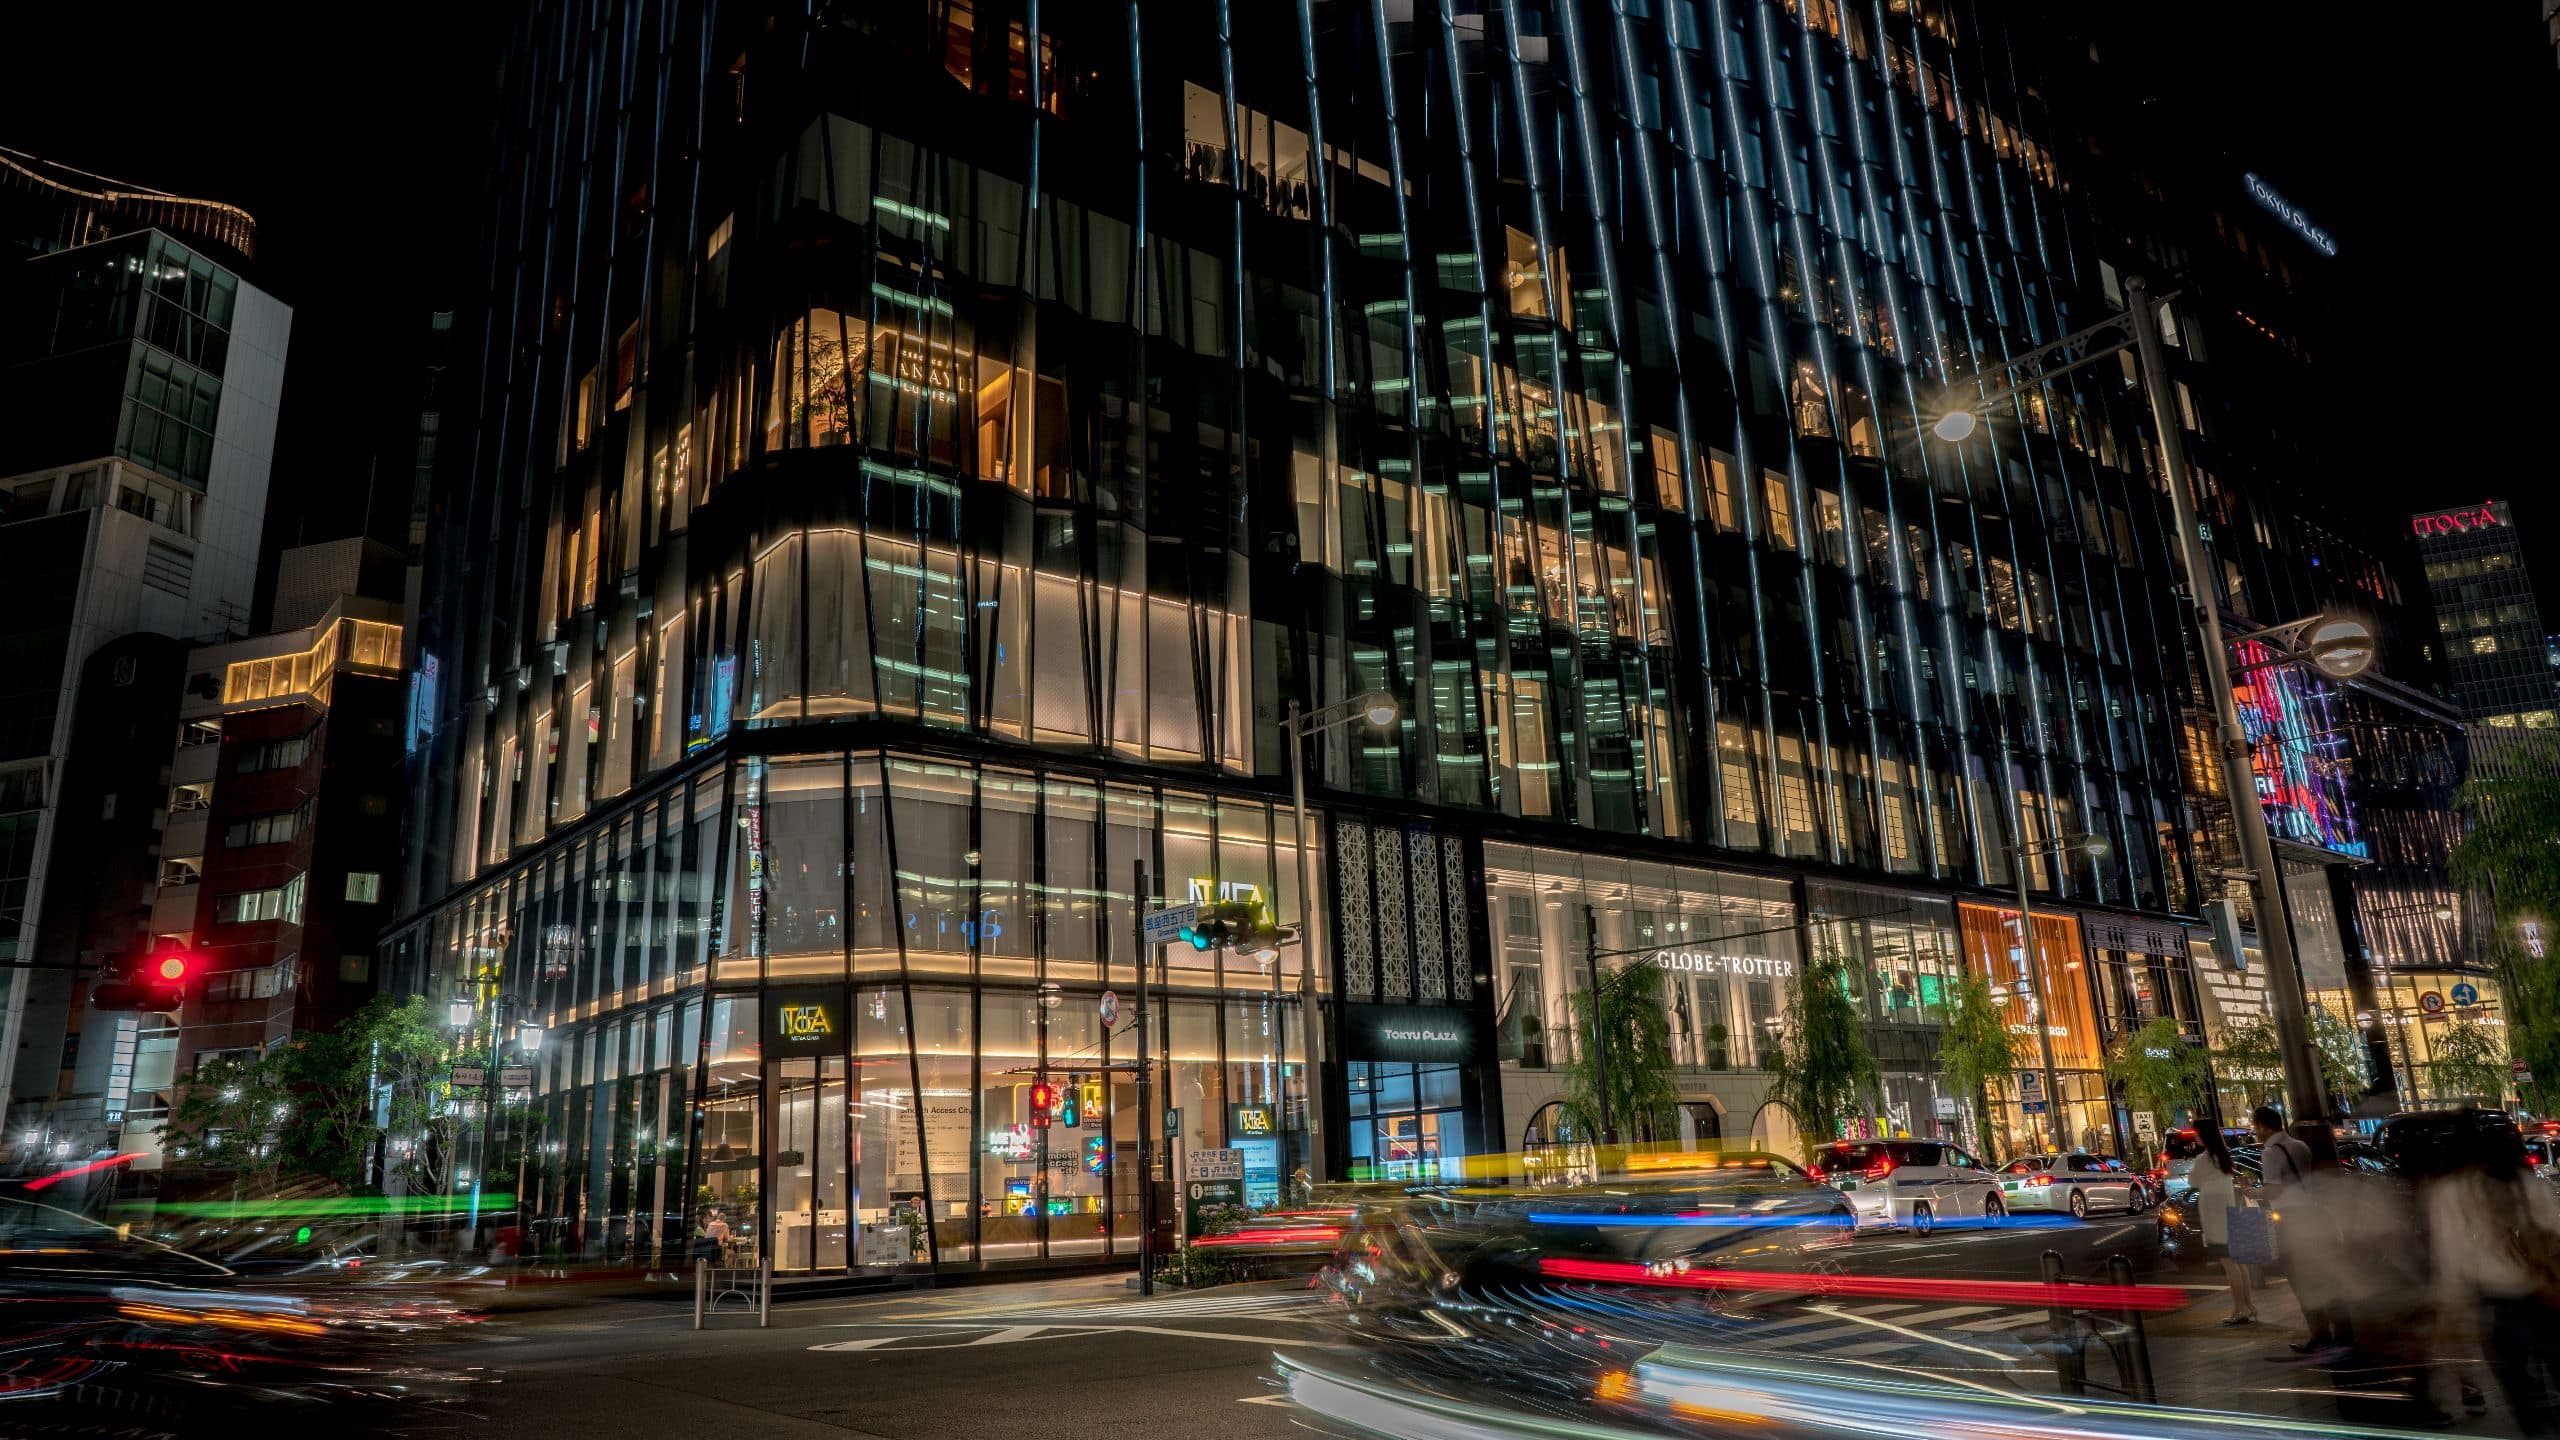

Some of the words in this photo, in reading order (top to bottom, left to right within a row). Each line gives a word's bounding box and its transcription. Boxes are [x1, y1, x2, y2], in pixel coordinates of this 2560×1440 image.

[2246, 173, 2290, 219] TOKYU
[2293, 212, 2334, 255] PLAZA
[1657, 951, 1793, 977] GLOBE-TROTTER
[2022, 1073, 2035, 1089] P
[2136, 1111, 2151, 1120] TAXI
[1047, 1151, 1078, 1160] mooth
[1047, 1160, 1078, 1168] ccess
